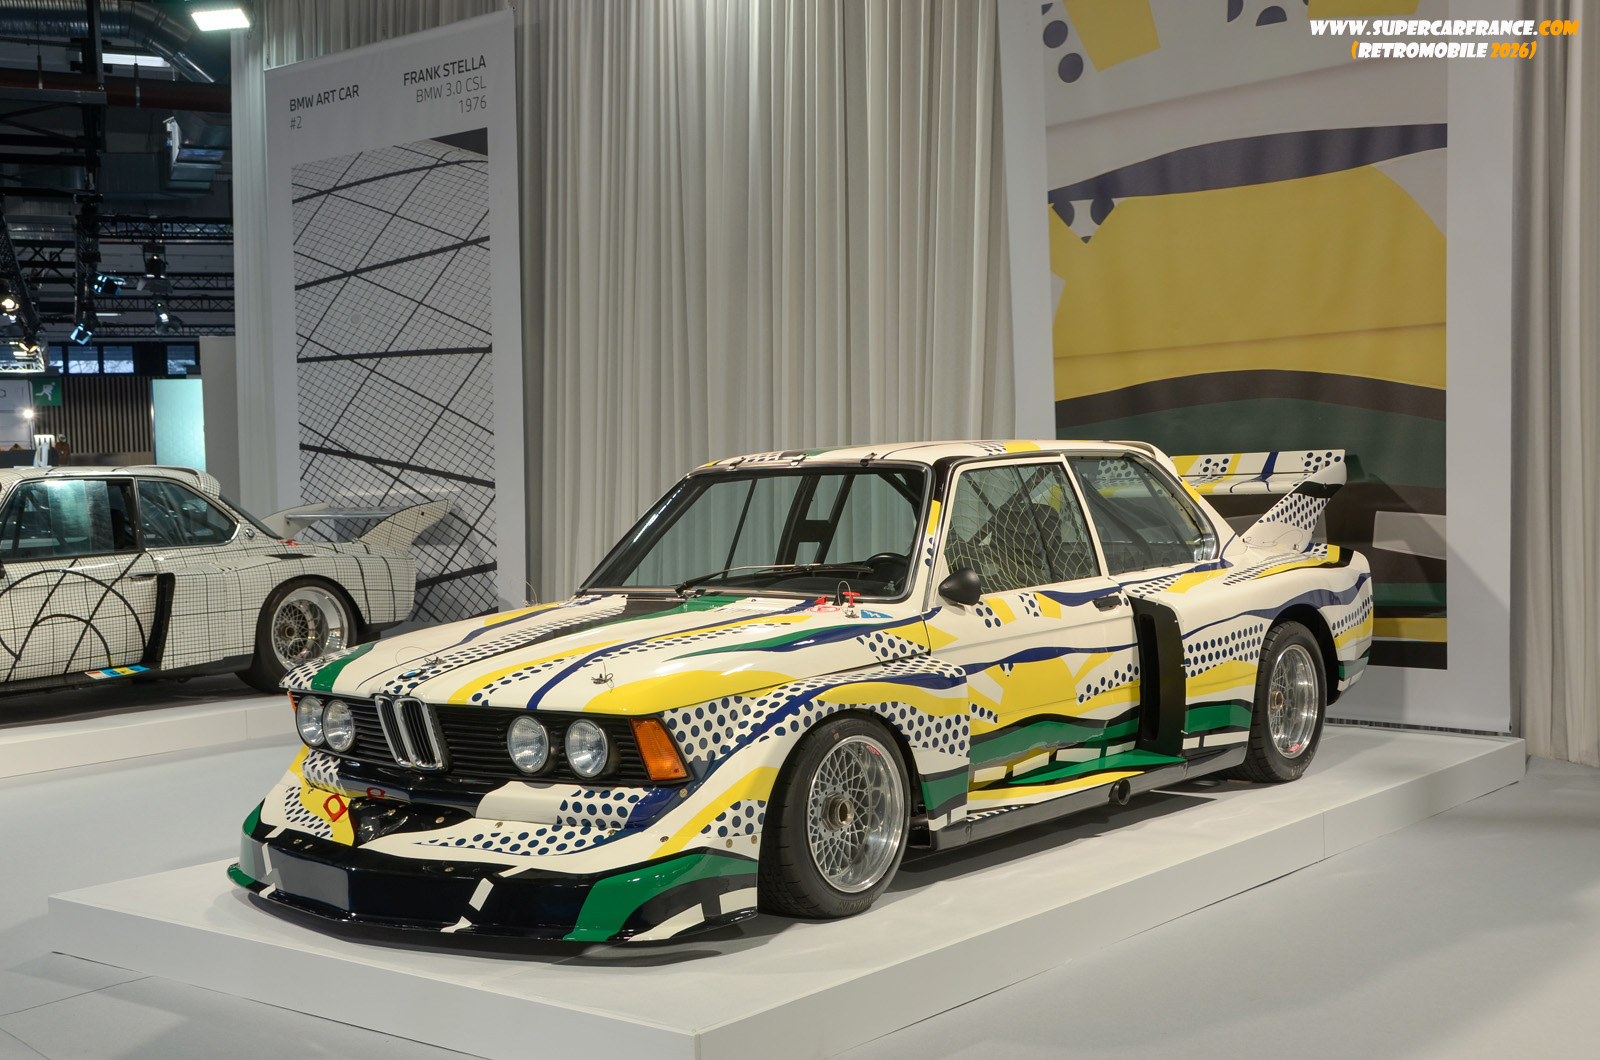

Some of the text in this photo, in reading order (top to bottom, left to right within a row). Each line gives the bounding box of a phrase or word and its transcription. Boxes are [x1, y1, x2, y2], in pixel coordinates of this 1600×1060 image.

[403, 55, 487, 86] FRANK STELLA
[289, 84, 360, 112] BMW ART CAR
[416, 75, 487, 103] BMW 3.0 CSL
[458, 95, 487, 114] 1976
[290, 115, 302, 130] #2
